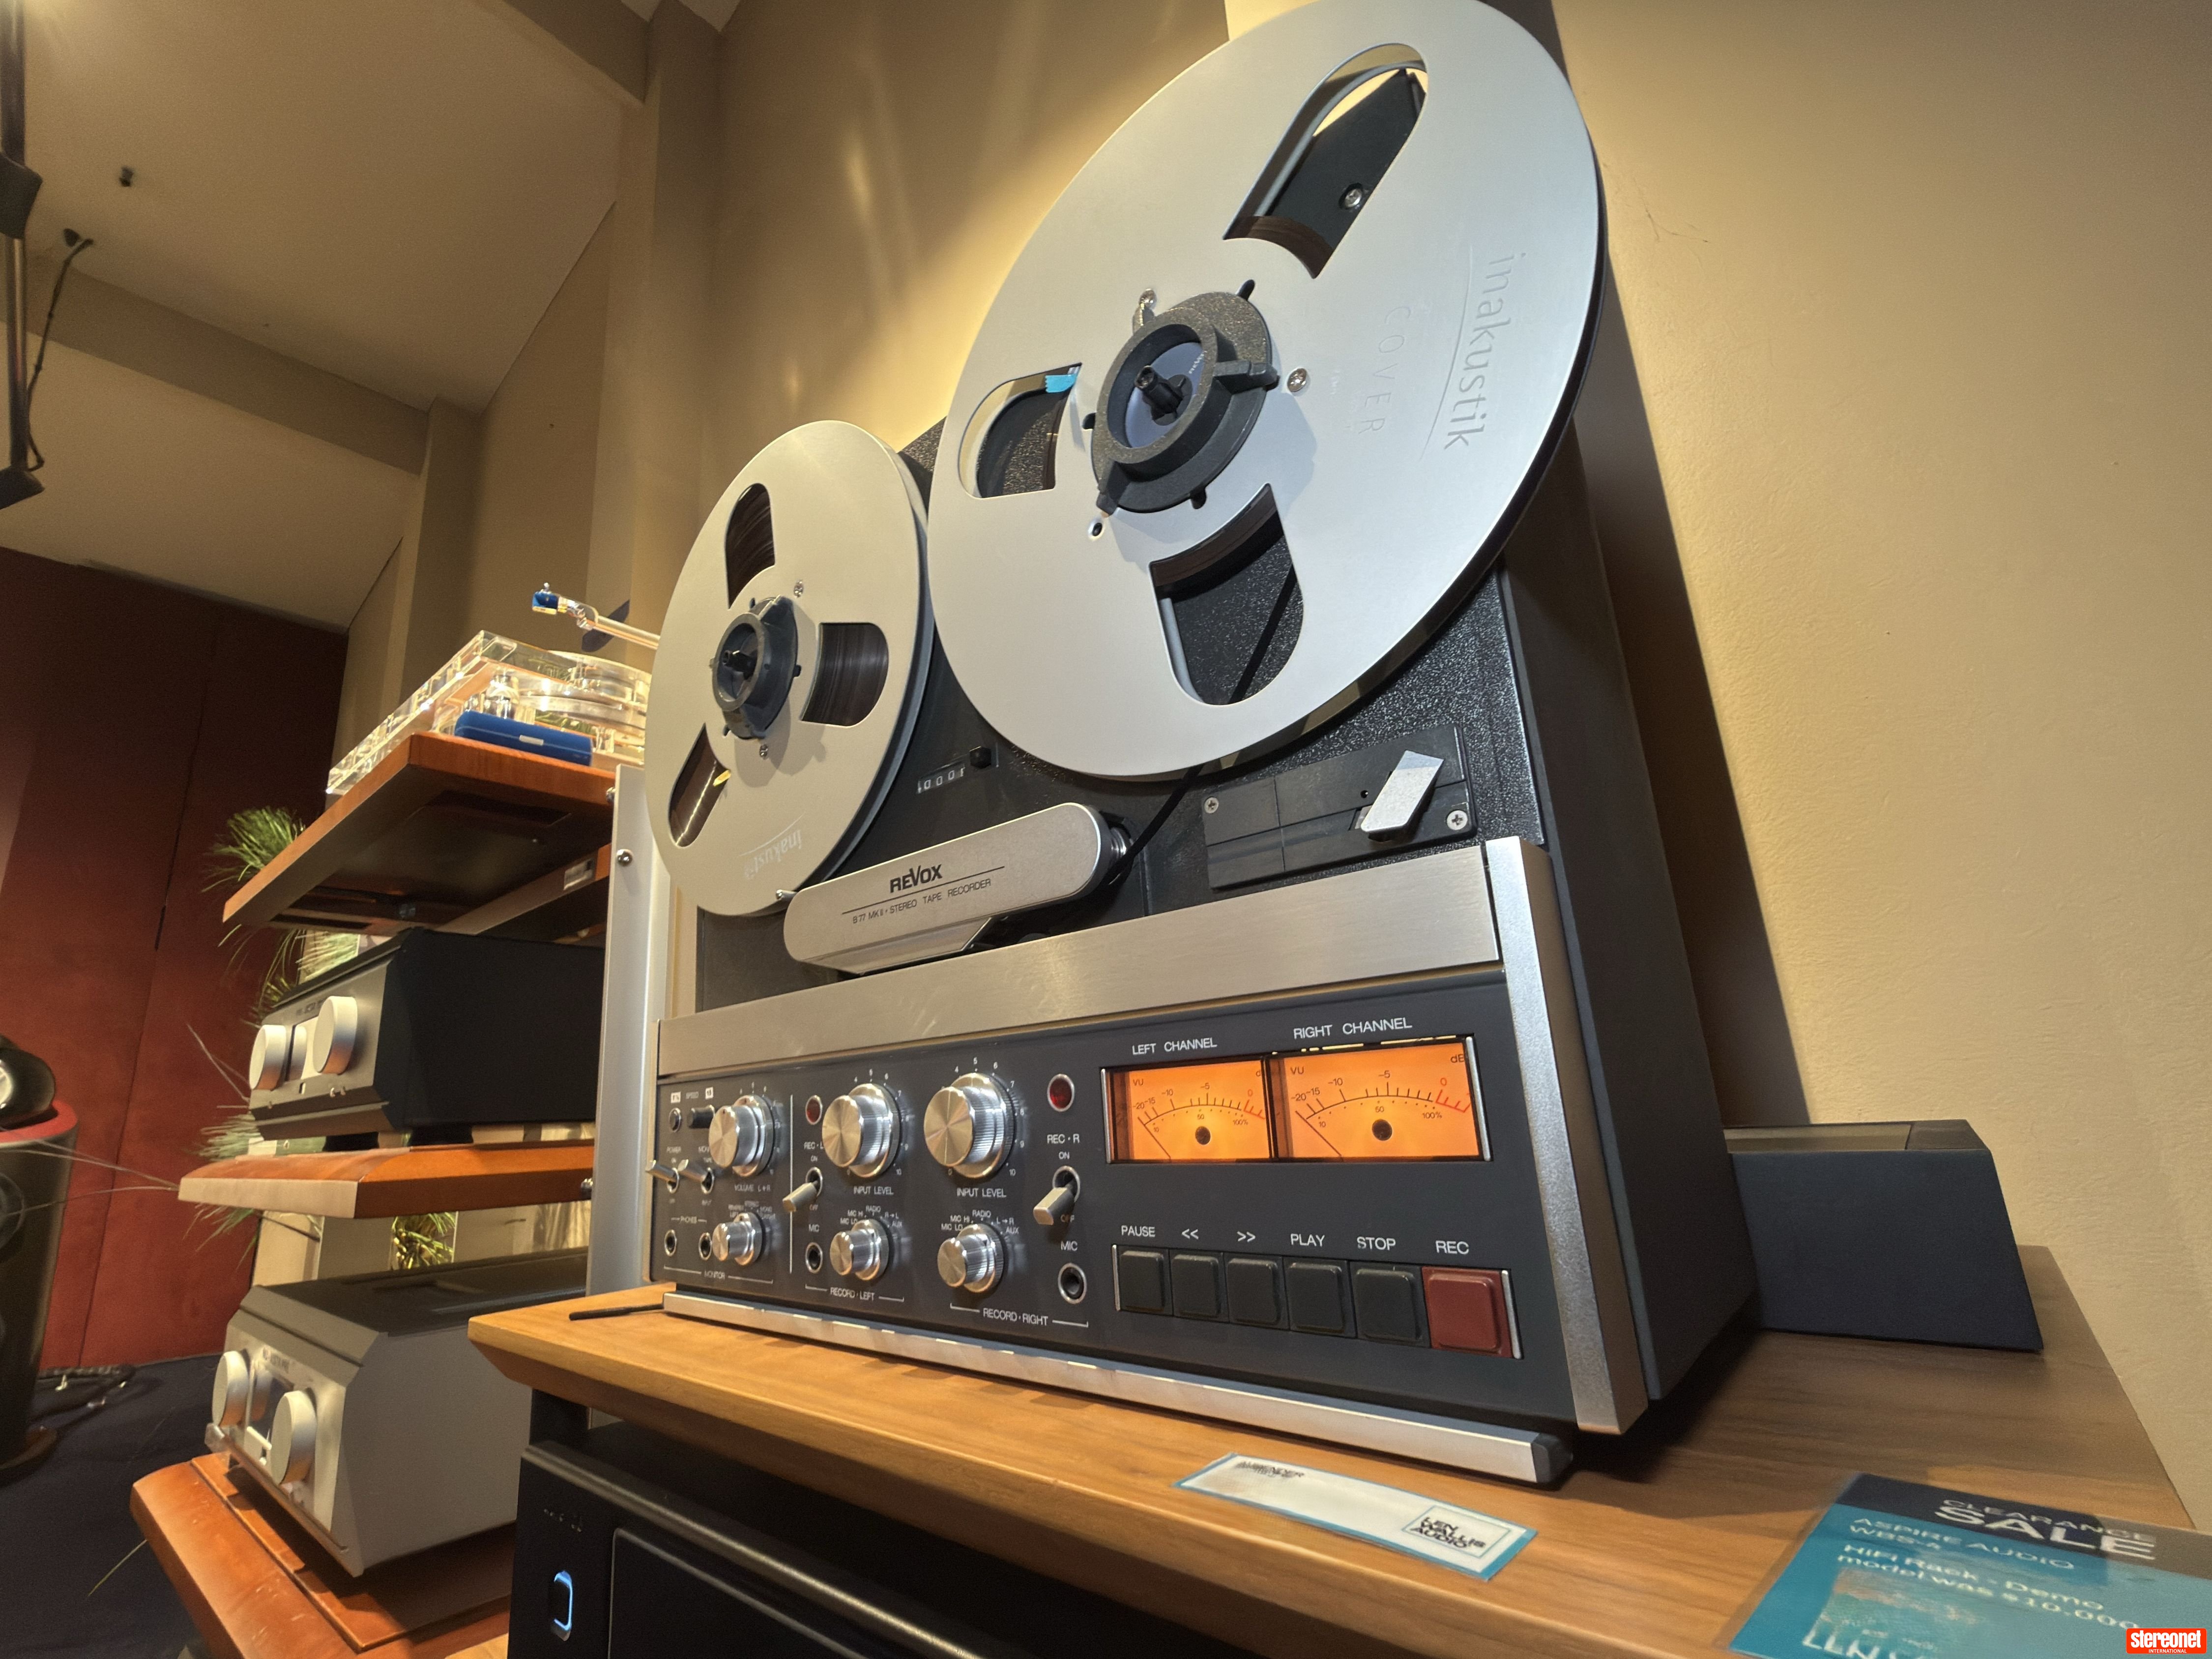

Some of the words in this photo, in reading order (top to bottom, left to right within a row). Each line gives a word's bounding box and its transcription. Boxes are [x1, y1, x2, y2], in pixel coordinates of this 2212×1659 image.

[1444, 252, 1526, 450] inakustik
[890, 899, 917, 914] STEREO
[923, 892, 942, 904] TAPE
[948, 878, 991, 897] RECORDER
[1293, 1024, 1333, 1039] RIGHT
[1342, 1017, 1413, 1035] CHANNEL
[1132, 1043, 1156, 1055] LEFT
[1164, 1037, 1218, 1053] CHANNEL
[1290, 1066, 1305, 1075] VU
[1378, 1070, 1391, 1079] -5
[1328, 1078, 1343, 1086] -10
[1440, 1077, 1447, 1086] 0
[1162, 1089, 1173, 1097] -10
[1248, 1089, 1253, 1097] 0
[1306, 1087, 1320, 1096] -15
[1291, 1093, 1307, 1102] -20
[1422, 1111, 1443, 1120] 100%
[734, 1184, 754, 1192] VOLUME
[853, 1186, 871, 1195] INPUT
[874, 1186, 894, 1195] LEVEL
[957, 1188, 979, 1197] INPUT
[982, 1188, 1007, 1198] LEVEL
[972, 1210, 991, 1218] RADIO
[1121, 1225, 1156, 1238] PAUSE
[1290, 1233, 1326, 1247] PLAY
[1356, 1236, 1397, 1251] STOP
[1060, 1241, 1078, 1251] MIC
[1435, 1240, 1469, 1255] REC
[704, 1270, 726, 1280] MONITOR
[1943, 1499, 2157, 1543] CLEARANCE
[1934, 1506, 2156, 1560] SALE
[1853, 1518, 1963, 1545] ASPIRE
[1966, 1542, 2075, 1570] AUDIO
[1837, 1554, 1924, 1580] model
[1931, 1574, 1994, 1597] was
[1904, 1557, 1979, 1582] Rack
[2006, 1580, 2104, 1611] Demo
